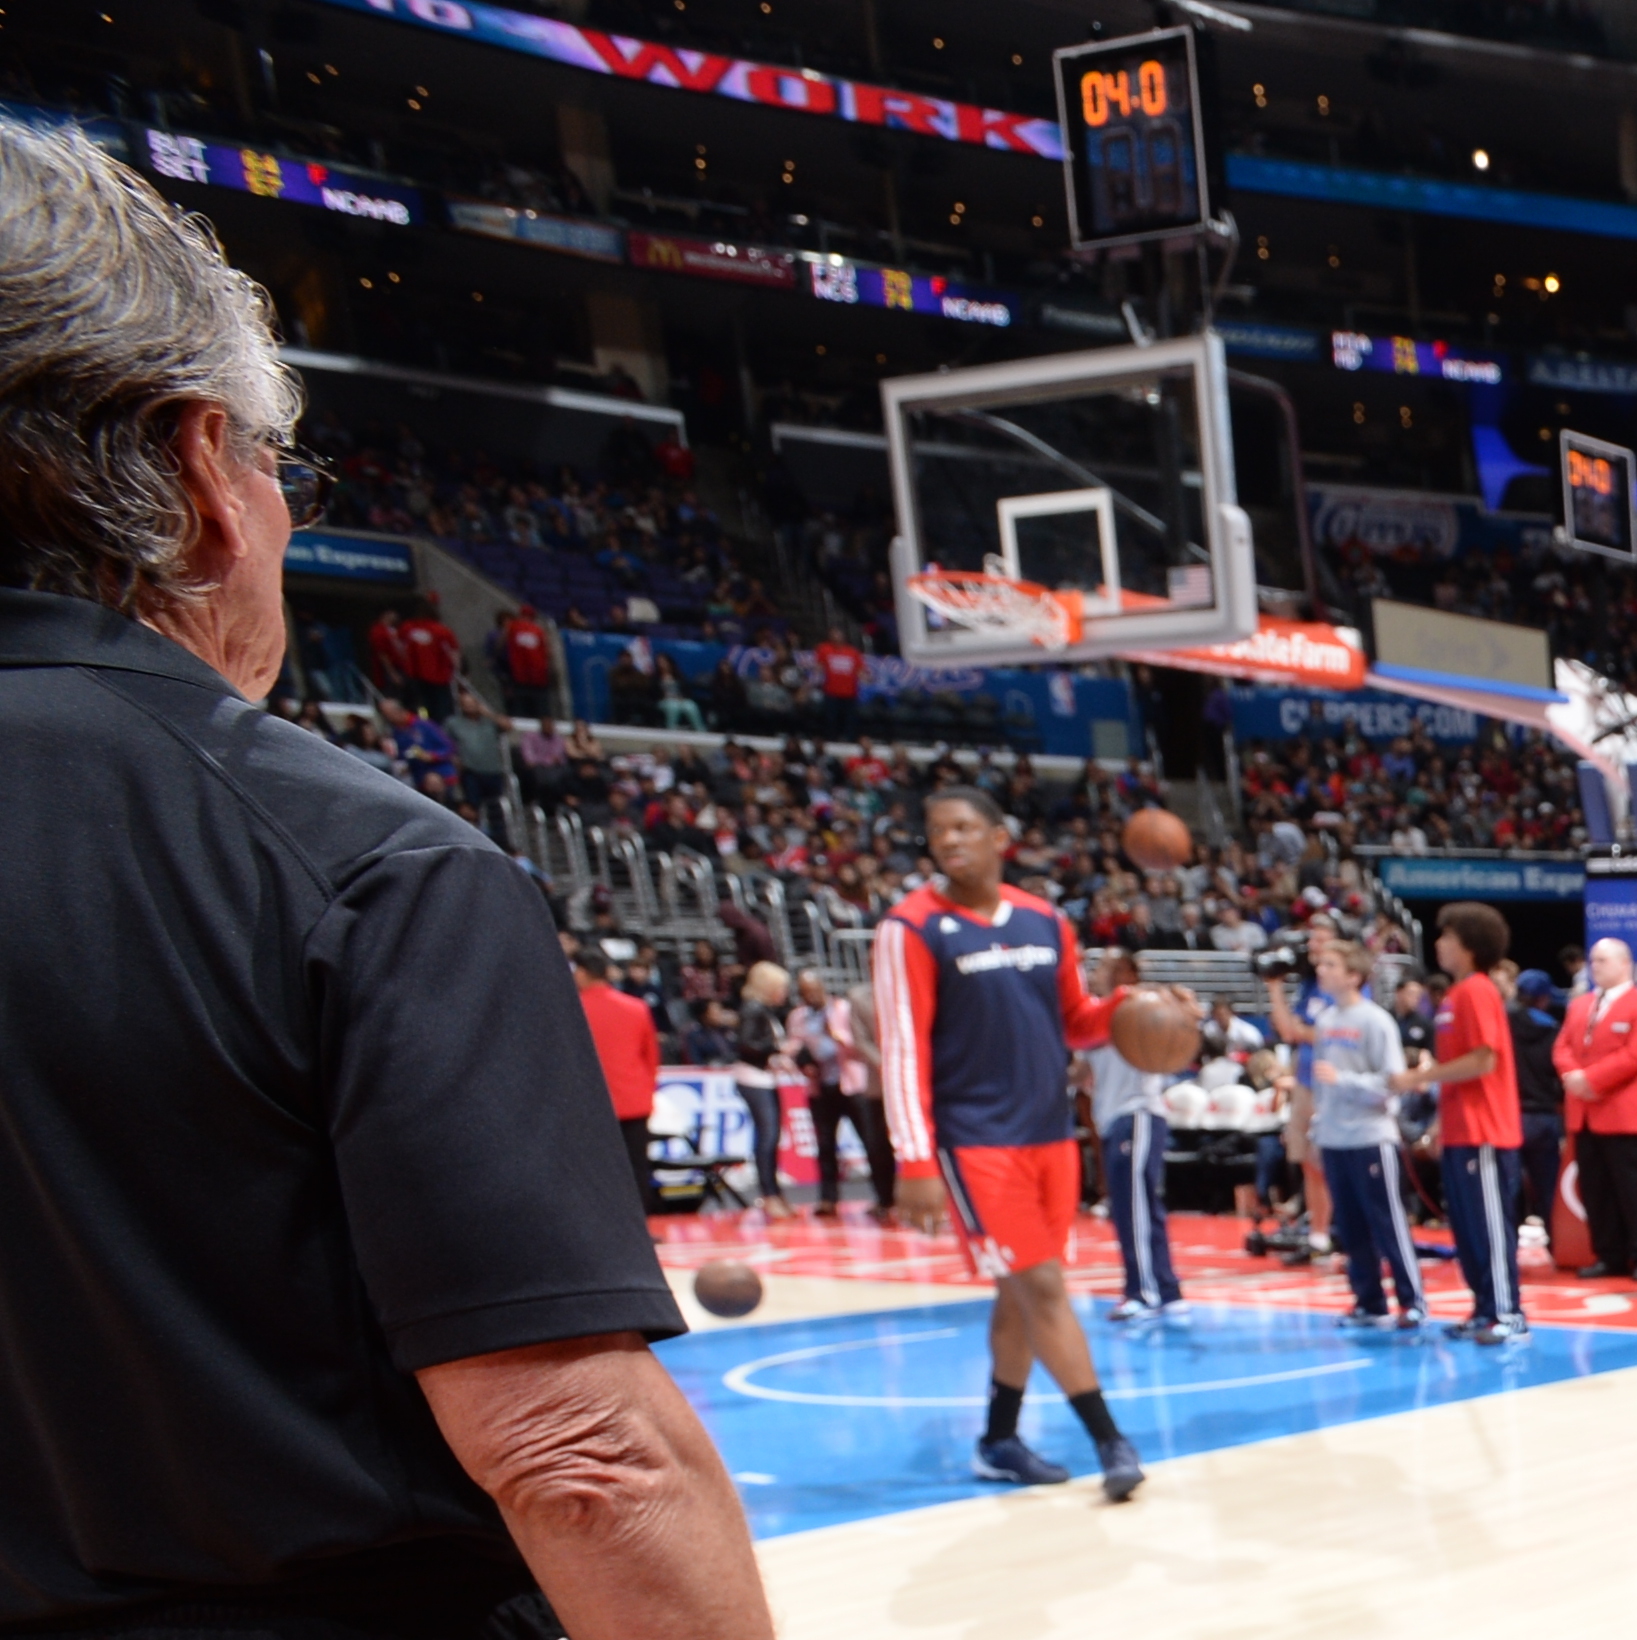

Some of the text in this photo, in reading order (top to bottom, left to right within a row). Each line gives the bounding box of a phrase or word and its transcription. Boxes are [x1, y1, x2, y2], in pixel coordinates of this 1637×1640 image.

[575, 27, 1048, 157] WORK
[1080, 58, 1167, 127] 04.0
[314, 544, 409, 573] Express
[1385, 863, 1519, 892] American
